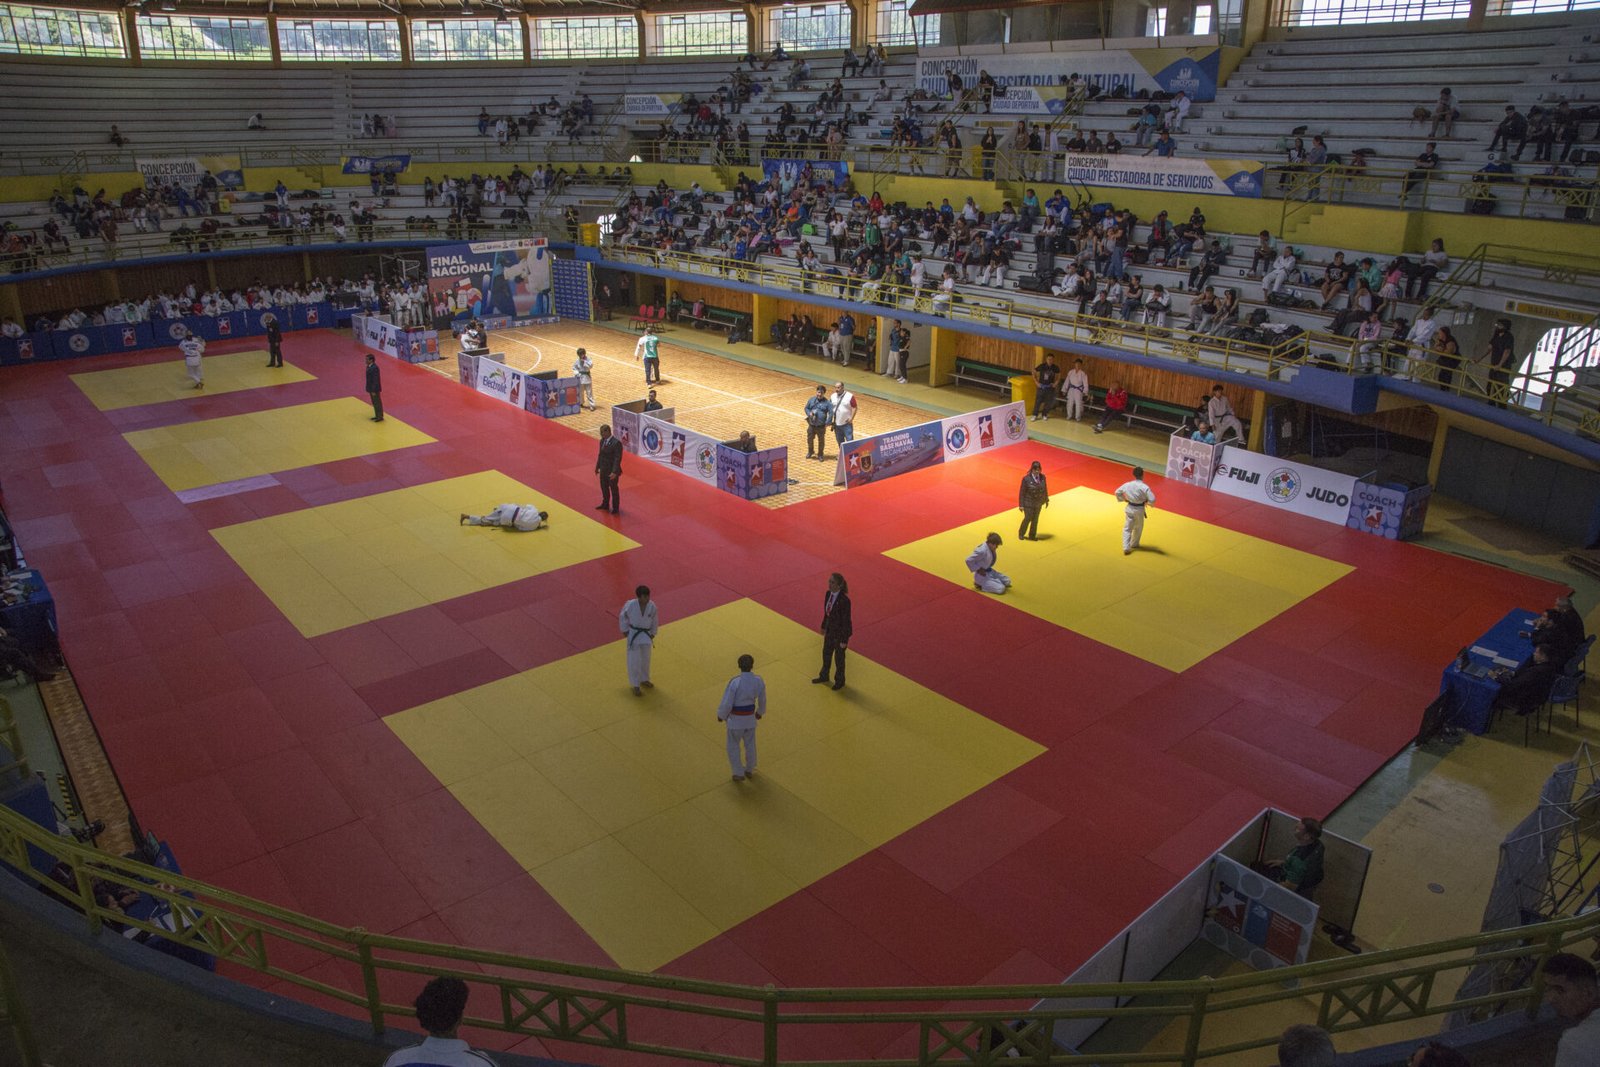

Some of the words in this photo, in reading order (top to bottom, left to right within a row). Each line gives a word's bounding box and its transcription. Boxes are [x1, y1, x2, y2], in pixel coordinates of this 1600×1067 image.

[921, 57, 978, 76] CONCEPCIÓN
[626, 95, 657, 105] CONCEPCIÓN
[993, 100, 1011, 109] CIUDAD
[1012, 100, 1039, 109] DEPORTIVA
[1068, 156, 1109, 168] CONCEPCIÓN
[1488, 153, 1495, 161] G
[140, 162, 196, 176] CONCEPCIÓN
[170, 174, 204, 184] DEPORTIV
[1068, 168, 1097, 182] CIUDAD
[1098, 169, 1151, 185] PRESTADORA
[1153, 173, 1164, 186] DE
[1167, 173, 1214, 189] SERVICIOS
[430, 255, 466, 267] FINAL
[431, 263, 494, 278] NACIONAL
[880, 442, 895, 452] BASE
[894, 437, 914, 447] NAVAL
[882, 432, 910, 444] TRAINING
[1175, 445, 1206, 460] COACH
[719, 454, 743, 468] COACH
[1228, 467, 1261, 485] FUJI
[1305, 486, 1349, 508] JUDO
[1358, 491, 1397, 508] COACH
